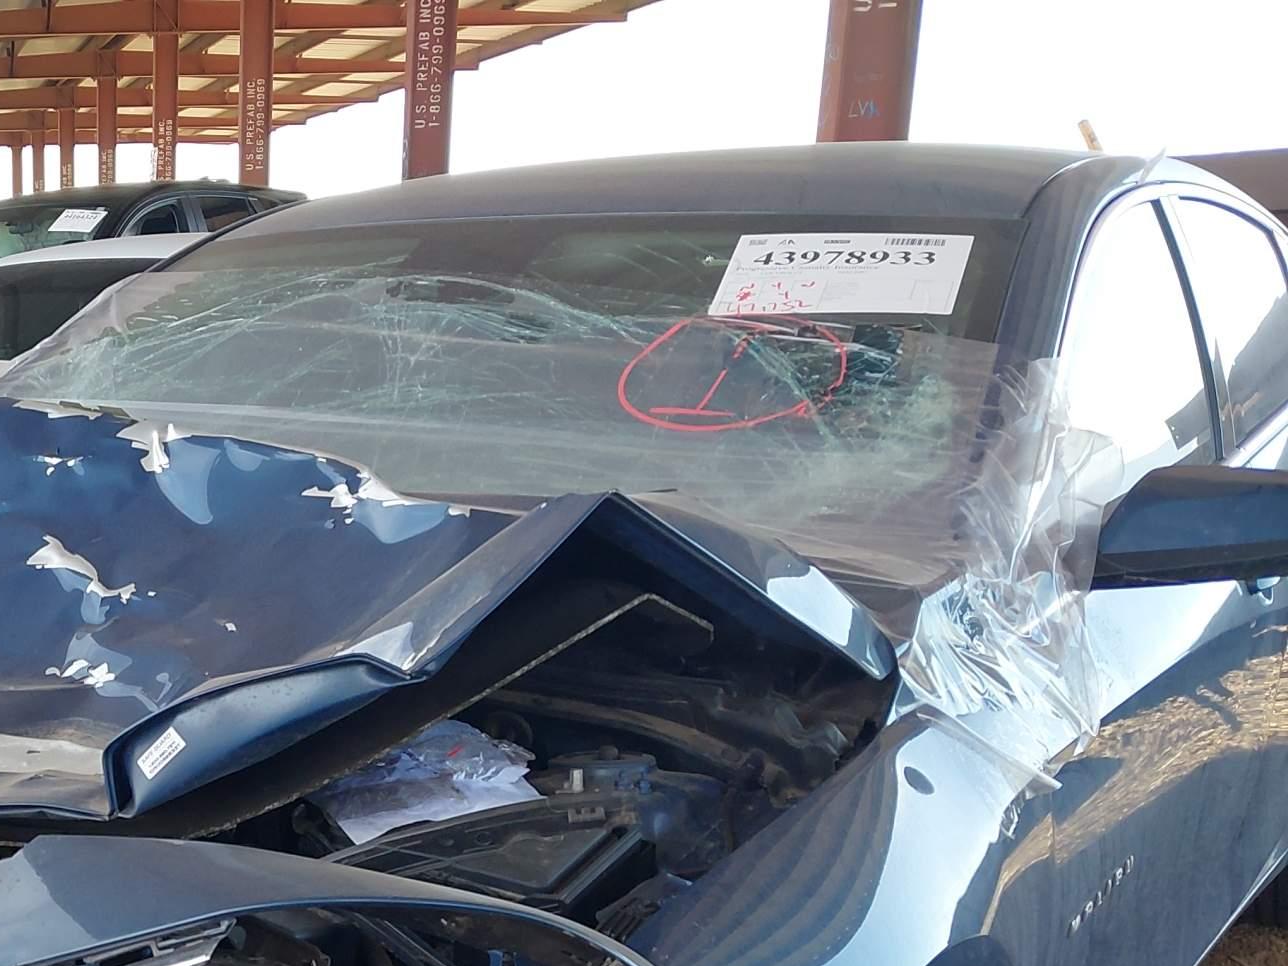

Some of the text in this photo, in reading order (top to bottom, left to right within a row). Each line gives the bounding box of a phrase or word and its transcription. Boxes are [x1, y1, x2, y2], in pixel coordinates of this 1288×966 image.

[416, 32, 430, 90] PREFAB
[246, 104, 255, 144] PREFAB
[752, 250, 937, 267] 43978933
